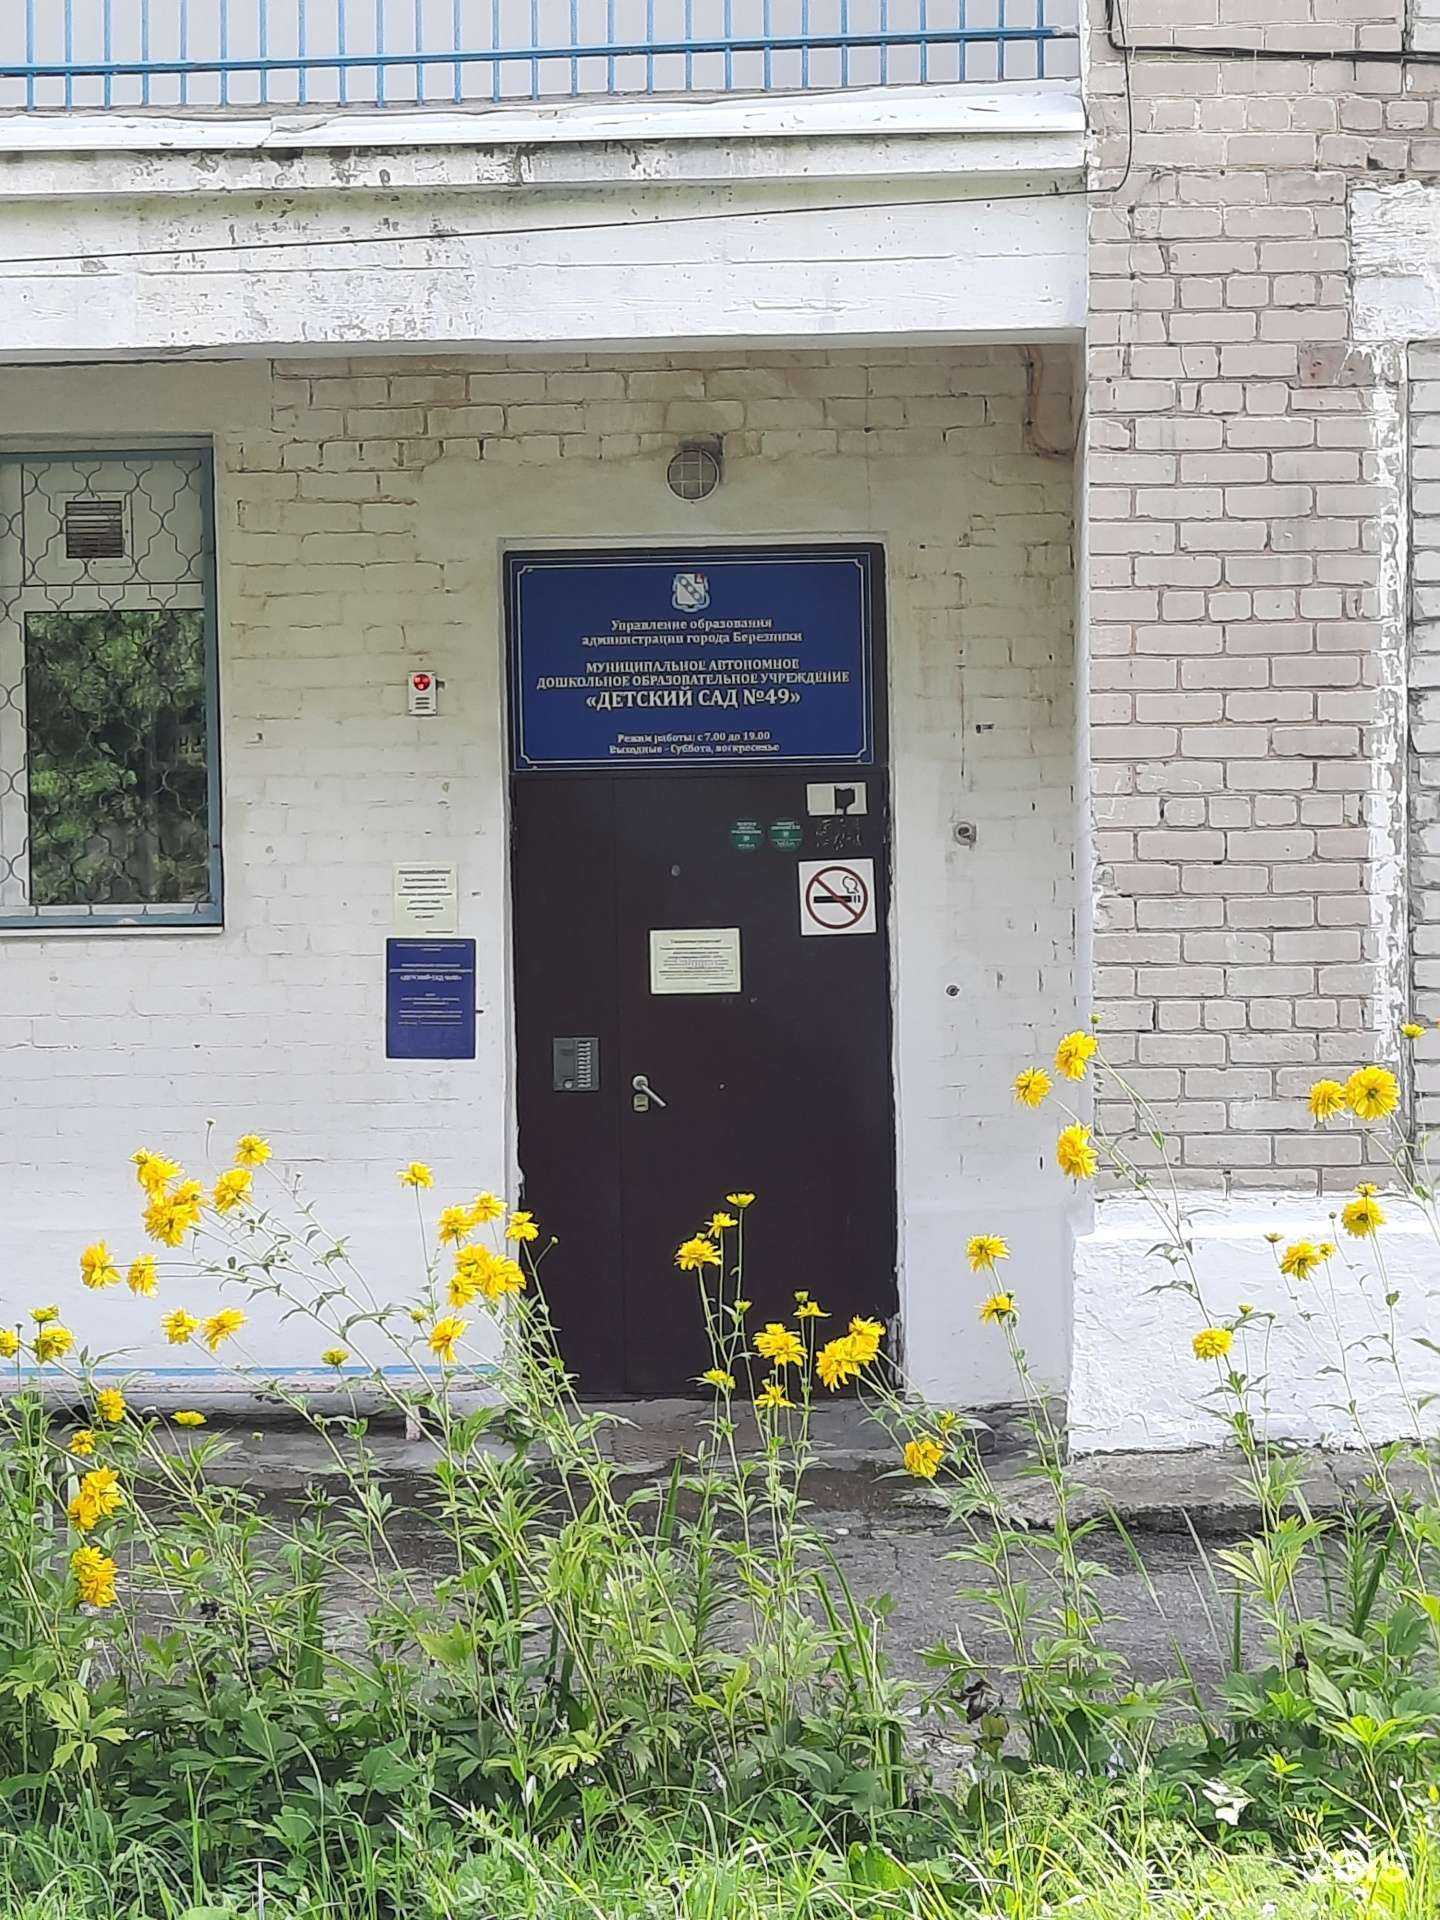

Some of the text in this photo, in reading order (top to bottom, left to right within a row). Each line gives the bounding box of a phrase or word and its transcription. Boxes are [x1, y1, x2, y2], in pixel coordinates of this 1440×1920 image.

[687, 633, 730, 646] города
[586, 658, 800, 675] МУНИЦИПАЛЬНОЕ АВТОНОМНОЕ
[536, 671, 850, 690] ДОШКОЛЬНОЕ ОБРАЗОВАТЕЛЬНОЕ УЧРЕЖДЕНИЕ
[586, 686, 801, 711] «ДЕТСКИЙ САД №49»
[704, 732, 726, 742] 7.00
[727, 734, 741, 743] до
[743, 731, 770, 741] 19.00
